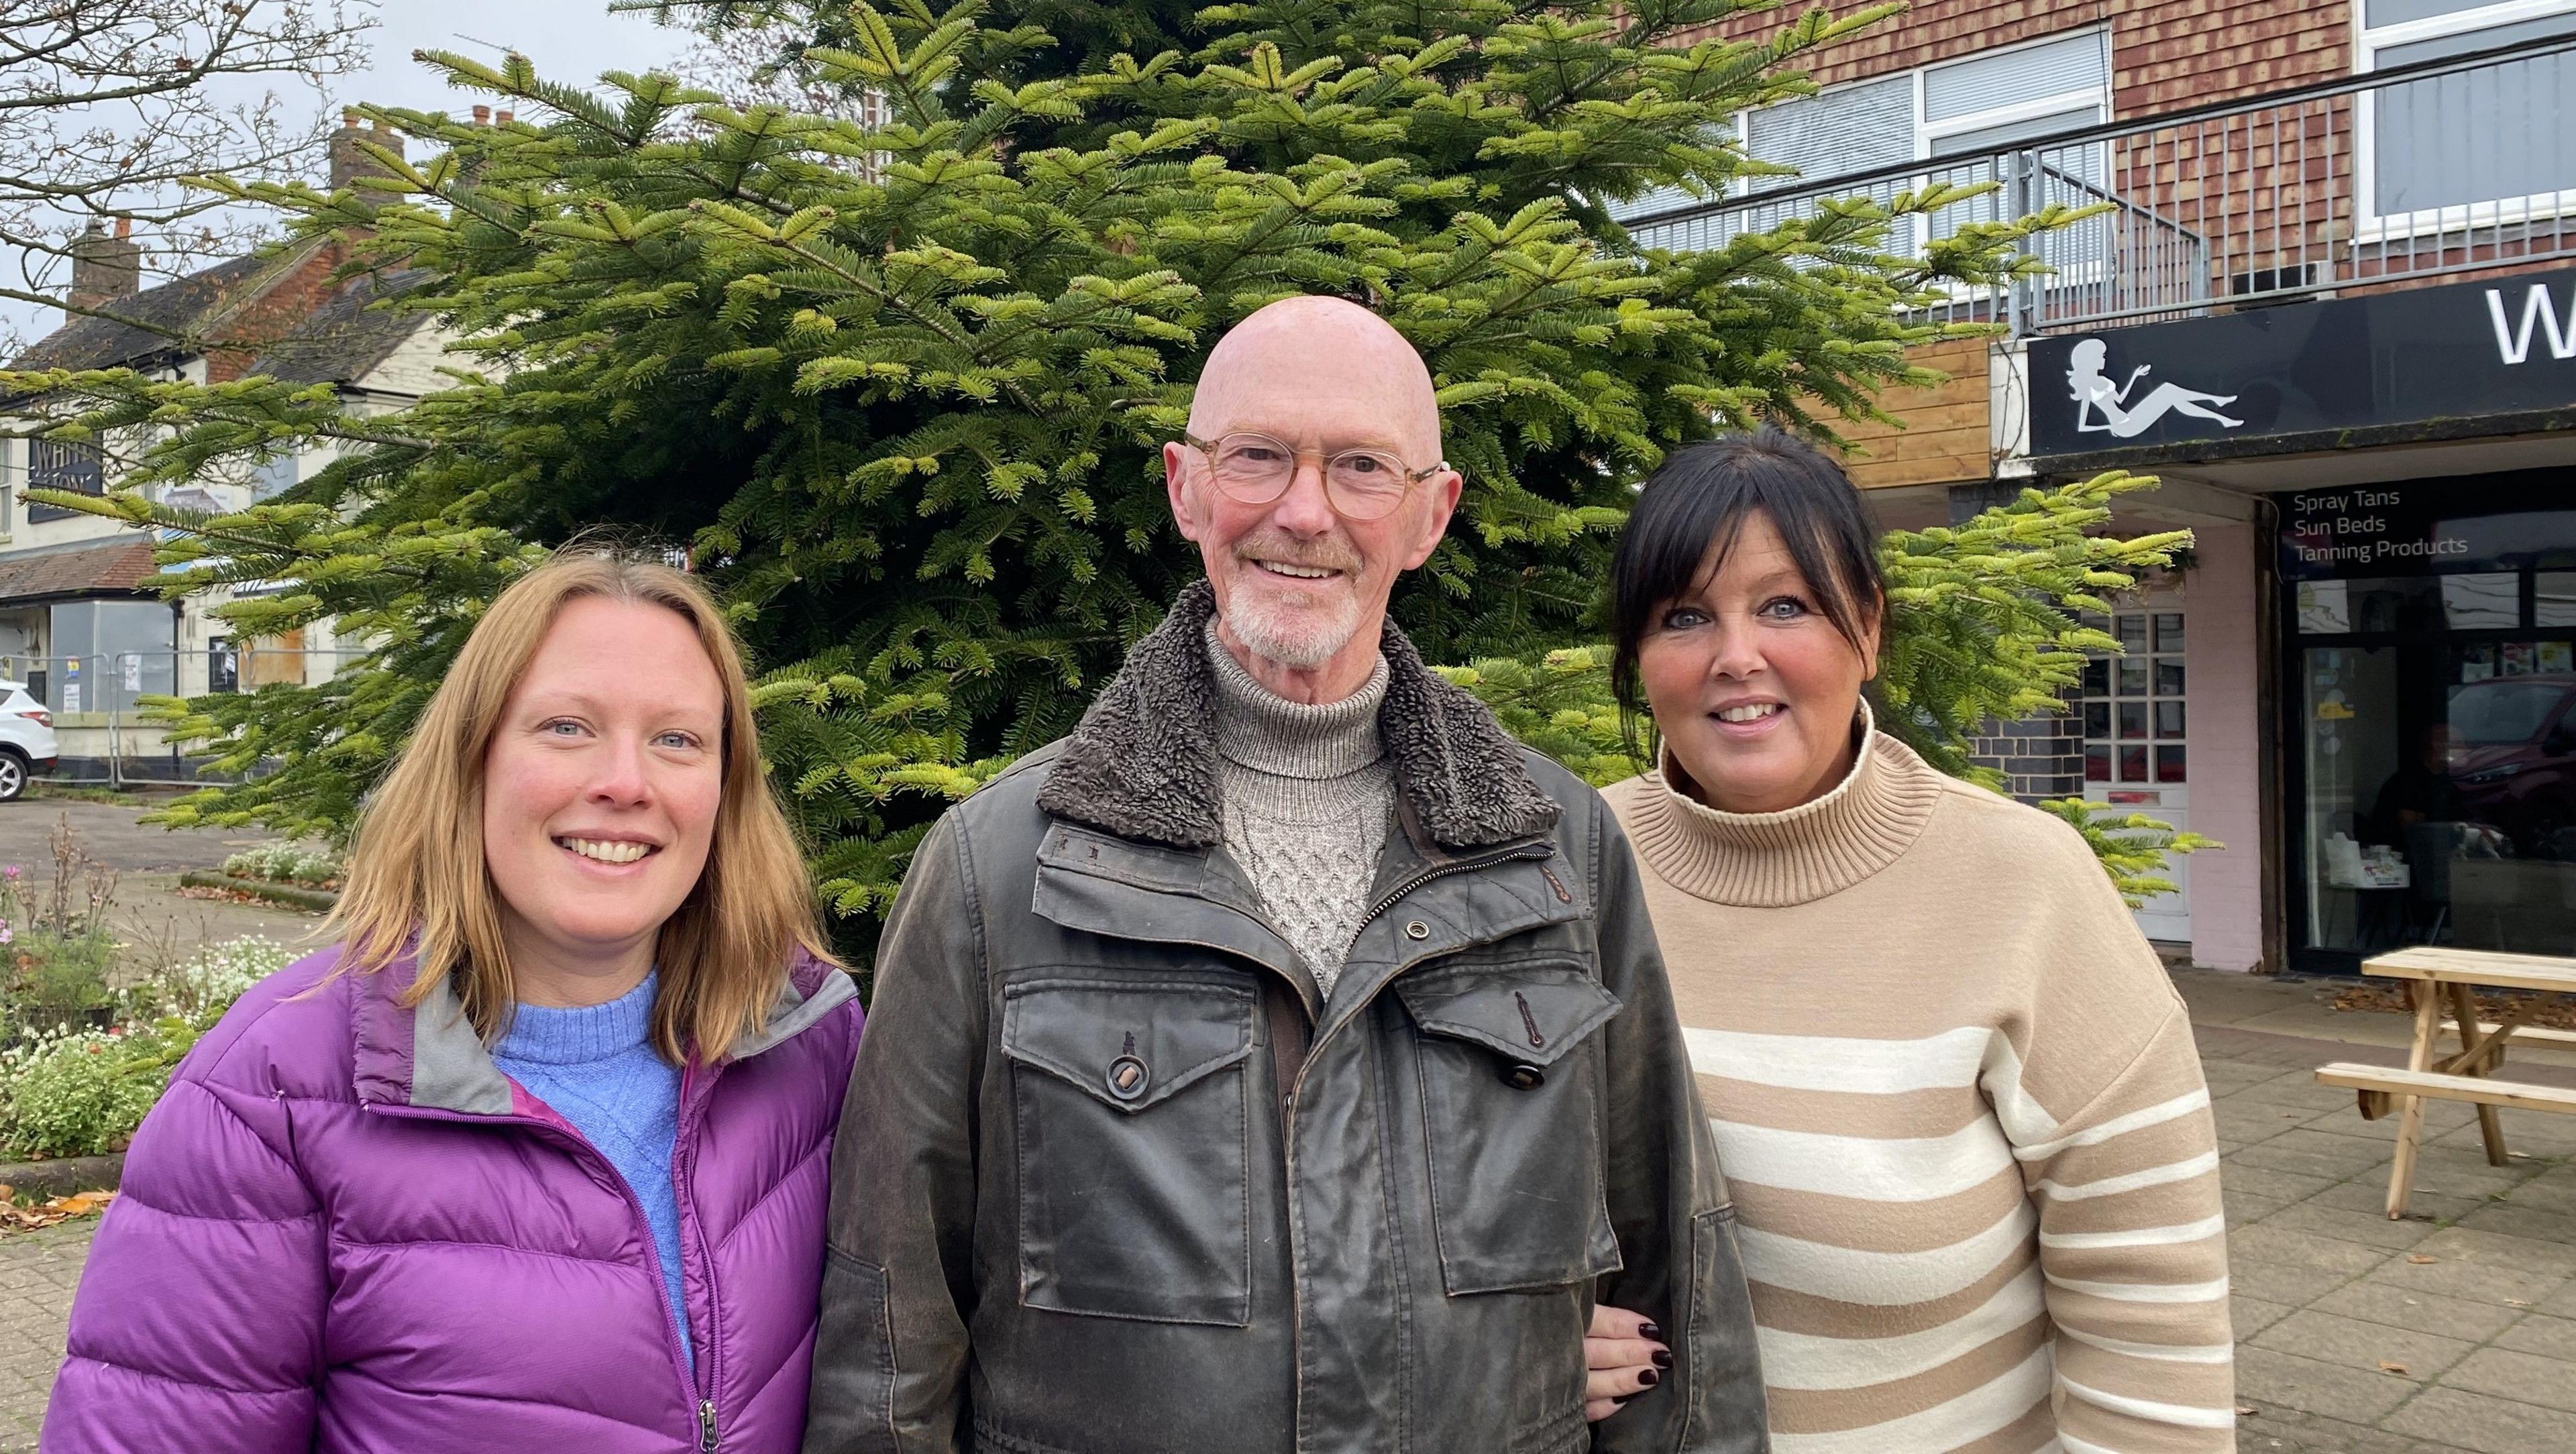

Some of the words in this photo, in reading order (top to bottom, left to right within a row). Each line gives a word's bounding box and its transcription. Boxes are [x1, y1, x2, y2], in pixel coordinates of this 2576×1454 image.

[2294, 494, 2348, 514] Spray
[2354, 490, 2400, 507] Tans
[2295, 520, 2330, 537] Sun
[2337, 515, 2386, 534] Beds
[2295, 543, 2371, 563] Tanning
[2376, 538, 2468, 557] Products
